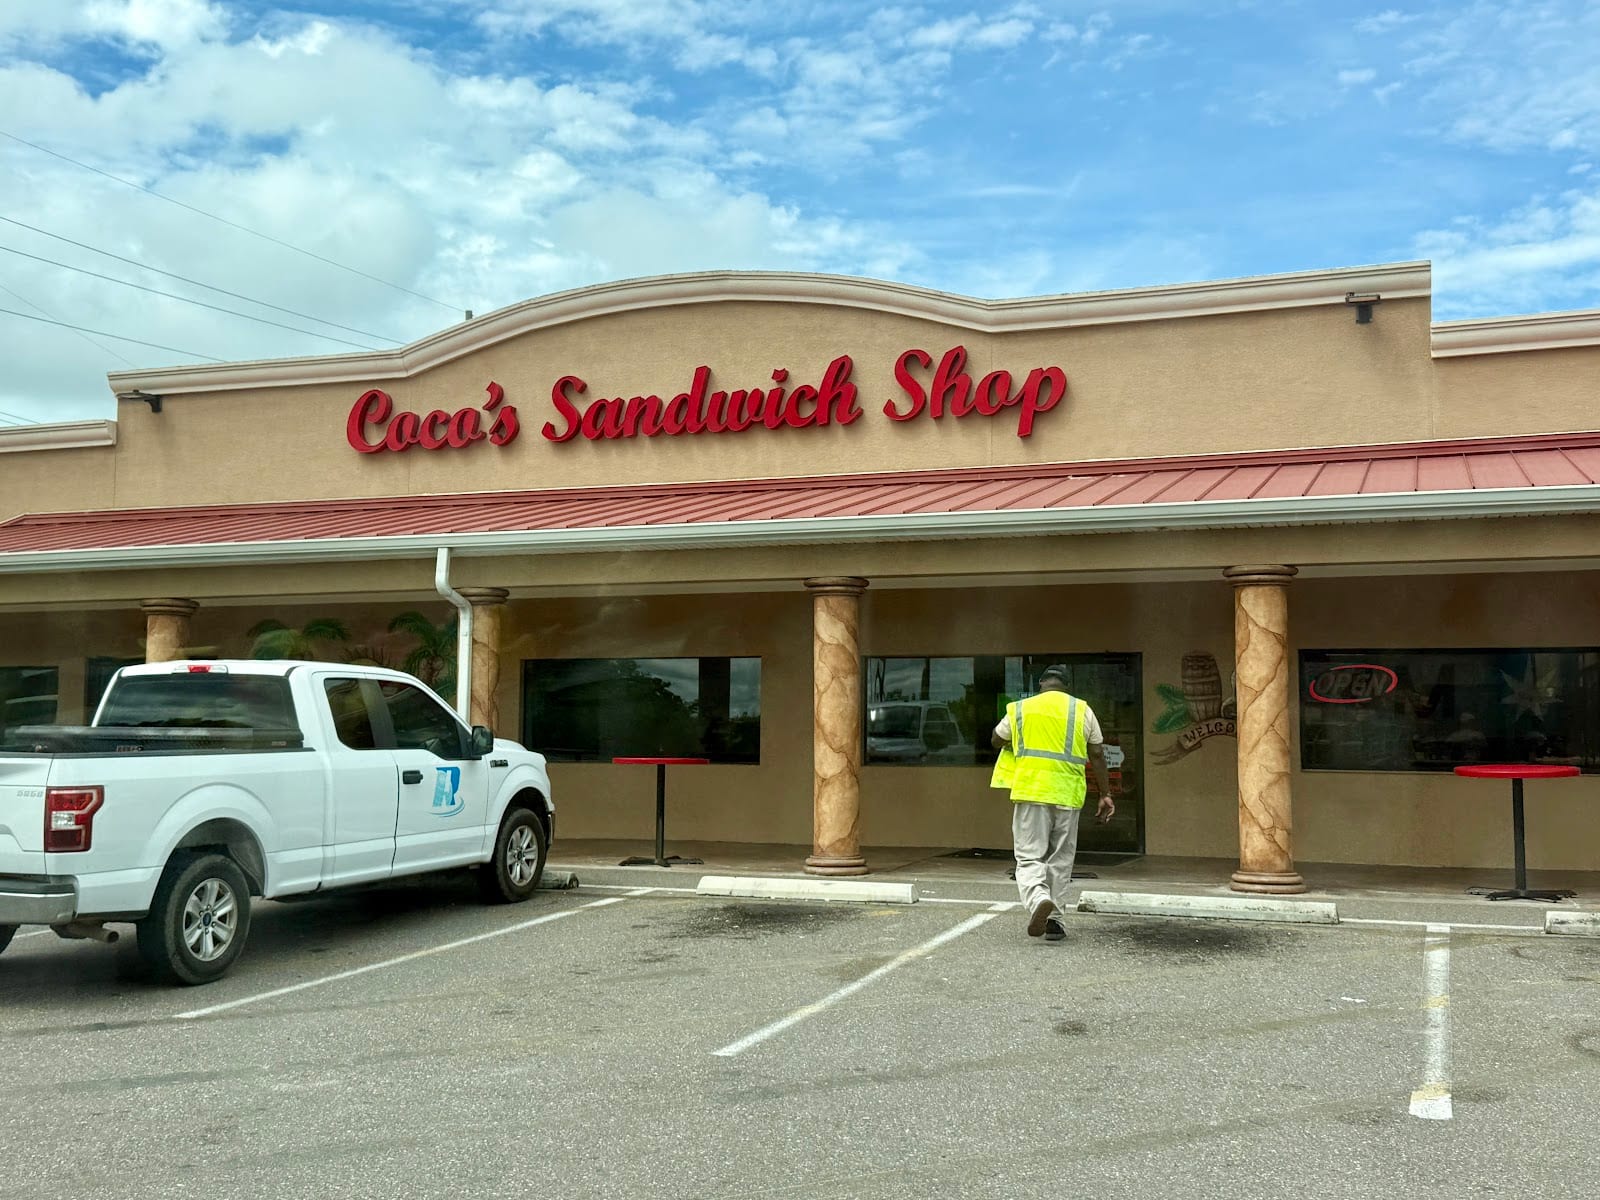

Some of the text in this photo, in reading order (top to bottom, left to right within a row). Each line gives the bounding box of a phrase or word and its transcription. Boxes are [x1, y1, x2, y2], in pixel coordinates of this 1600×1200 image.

[346, 345, 1067, 453] Coco's Sandwich Shop
[1315, 671, 1392, 697] OPEN
